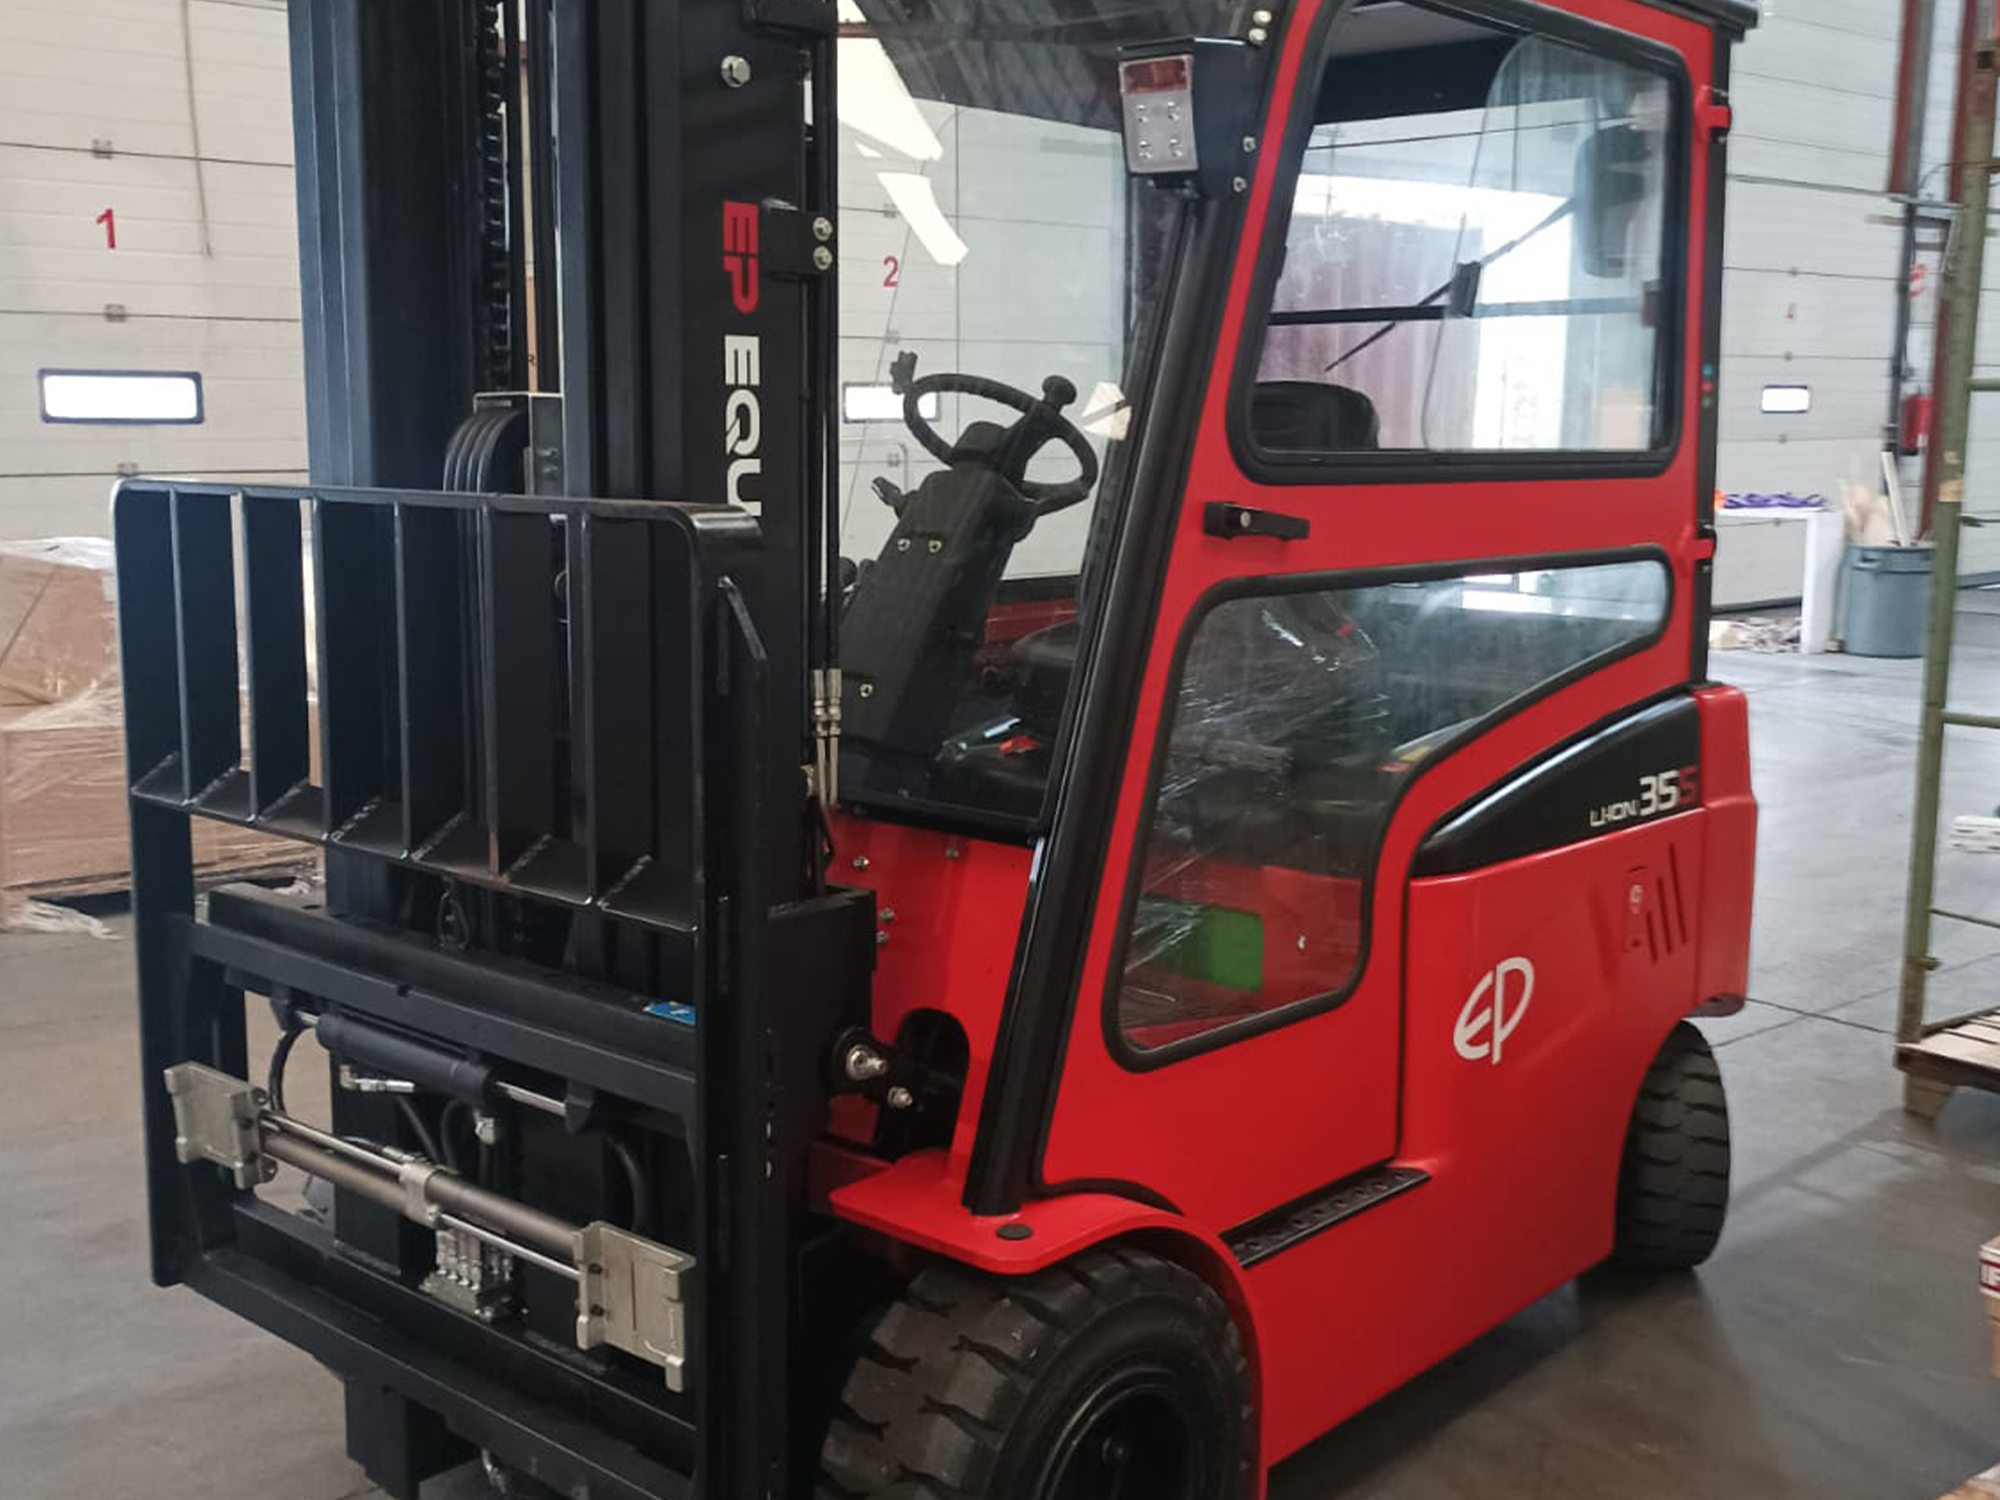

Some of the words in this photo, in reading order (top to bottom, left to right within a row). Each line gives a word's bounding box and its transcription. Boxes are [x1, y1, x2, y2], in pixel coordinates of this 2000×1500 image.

[96, 208, 116, 249] 1
[723, 201, 759, 314] EP
[883, 256, 899, 287] 2
[1453, 956, 1534, 1065] EP
